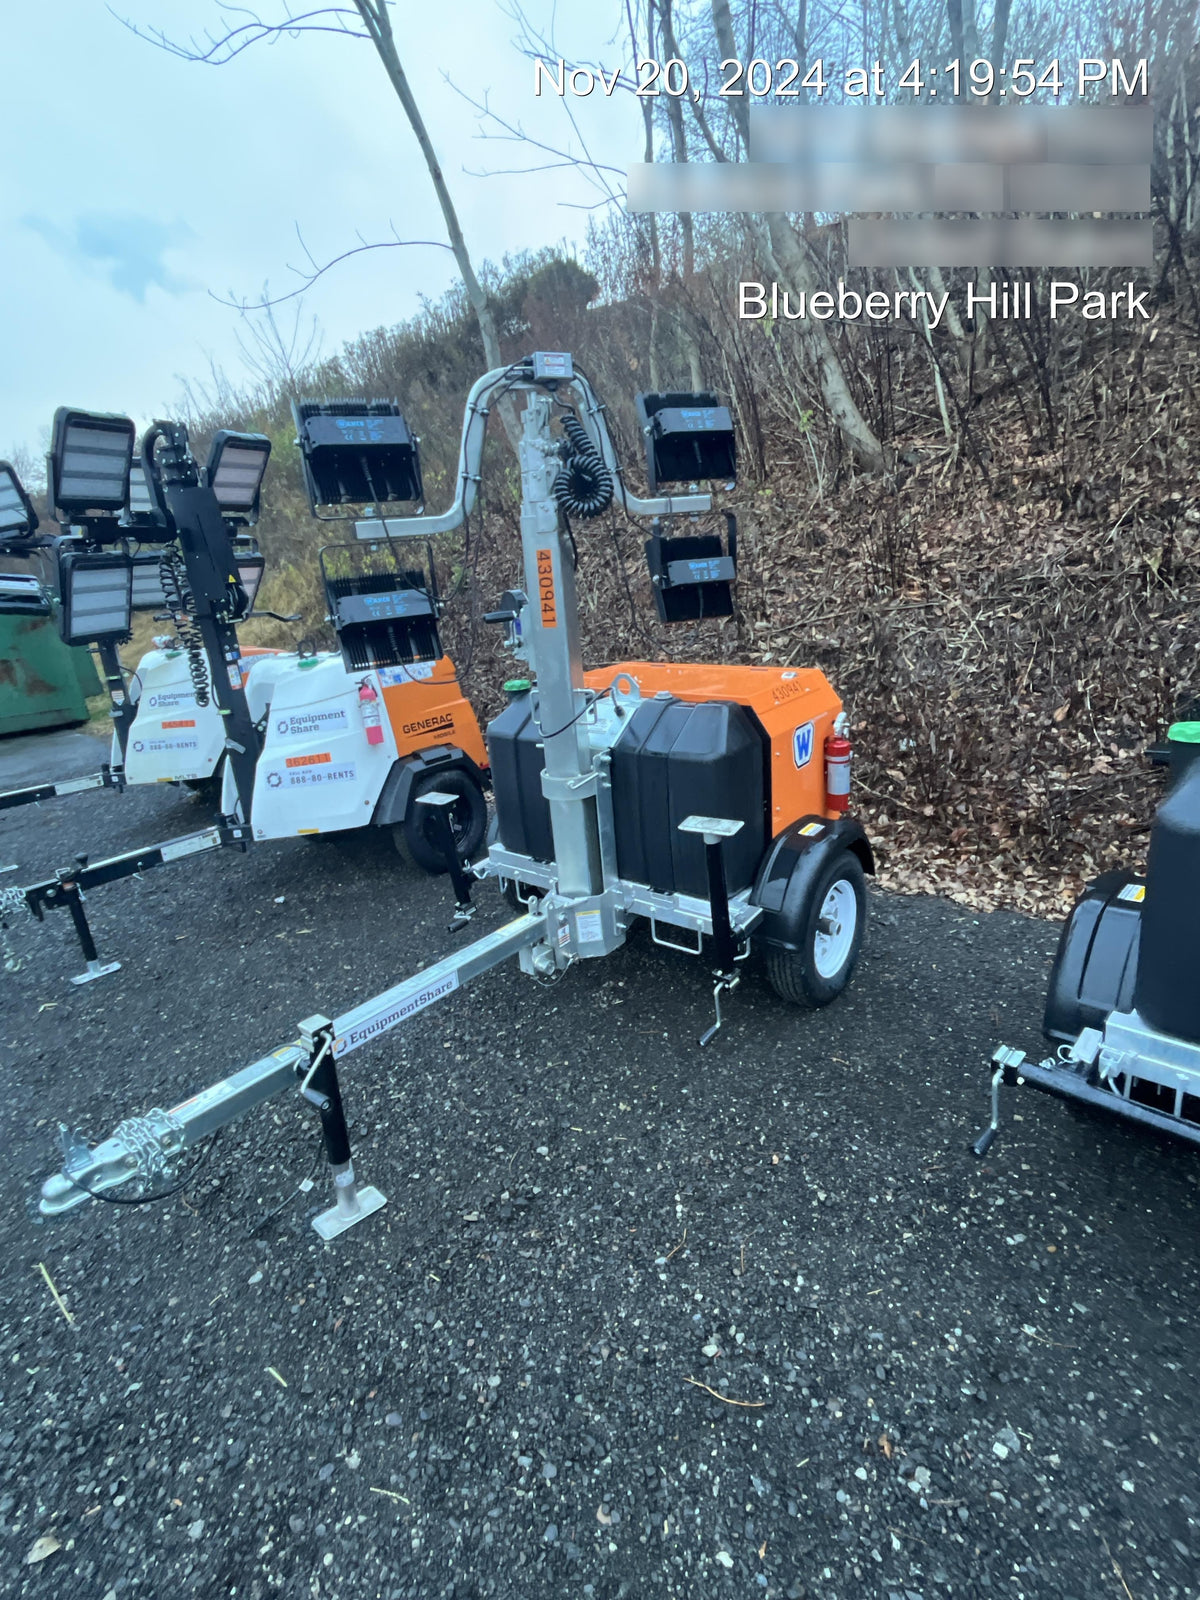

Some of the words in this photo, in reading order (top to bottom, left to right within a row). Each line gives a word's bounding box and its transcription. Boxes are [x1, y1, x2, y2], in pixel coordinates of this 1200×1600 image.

[537, 551, 557, 623] 430941
[289, 710, 346, 726] Equipment
[402, 713, 453, 734] GENERAC
[290, 723, 320, 734] Share
[290, 769, 355, 785] 888-80-RENTS
[350, 980, 453, 1045] EquipmentShare
